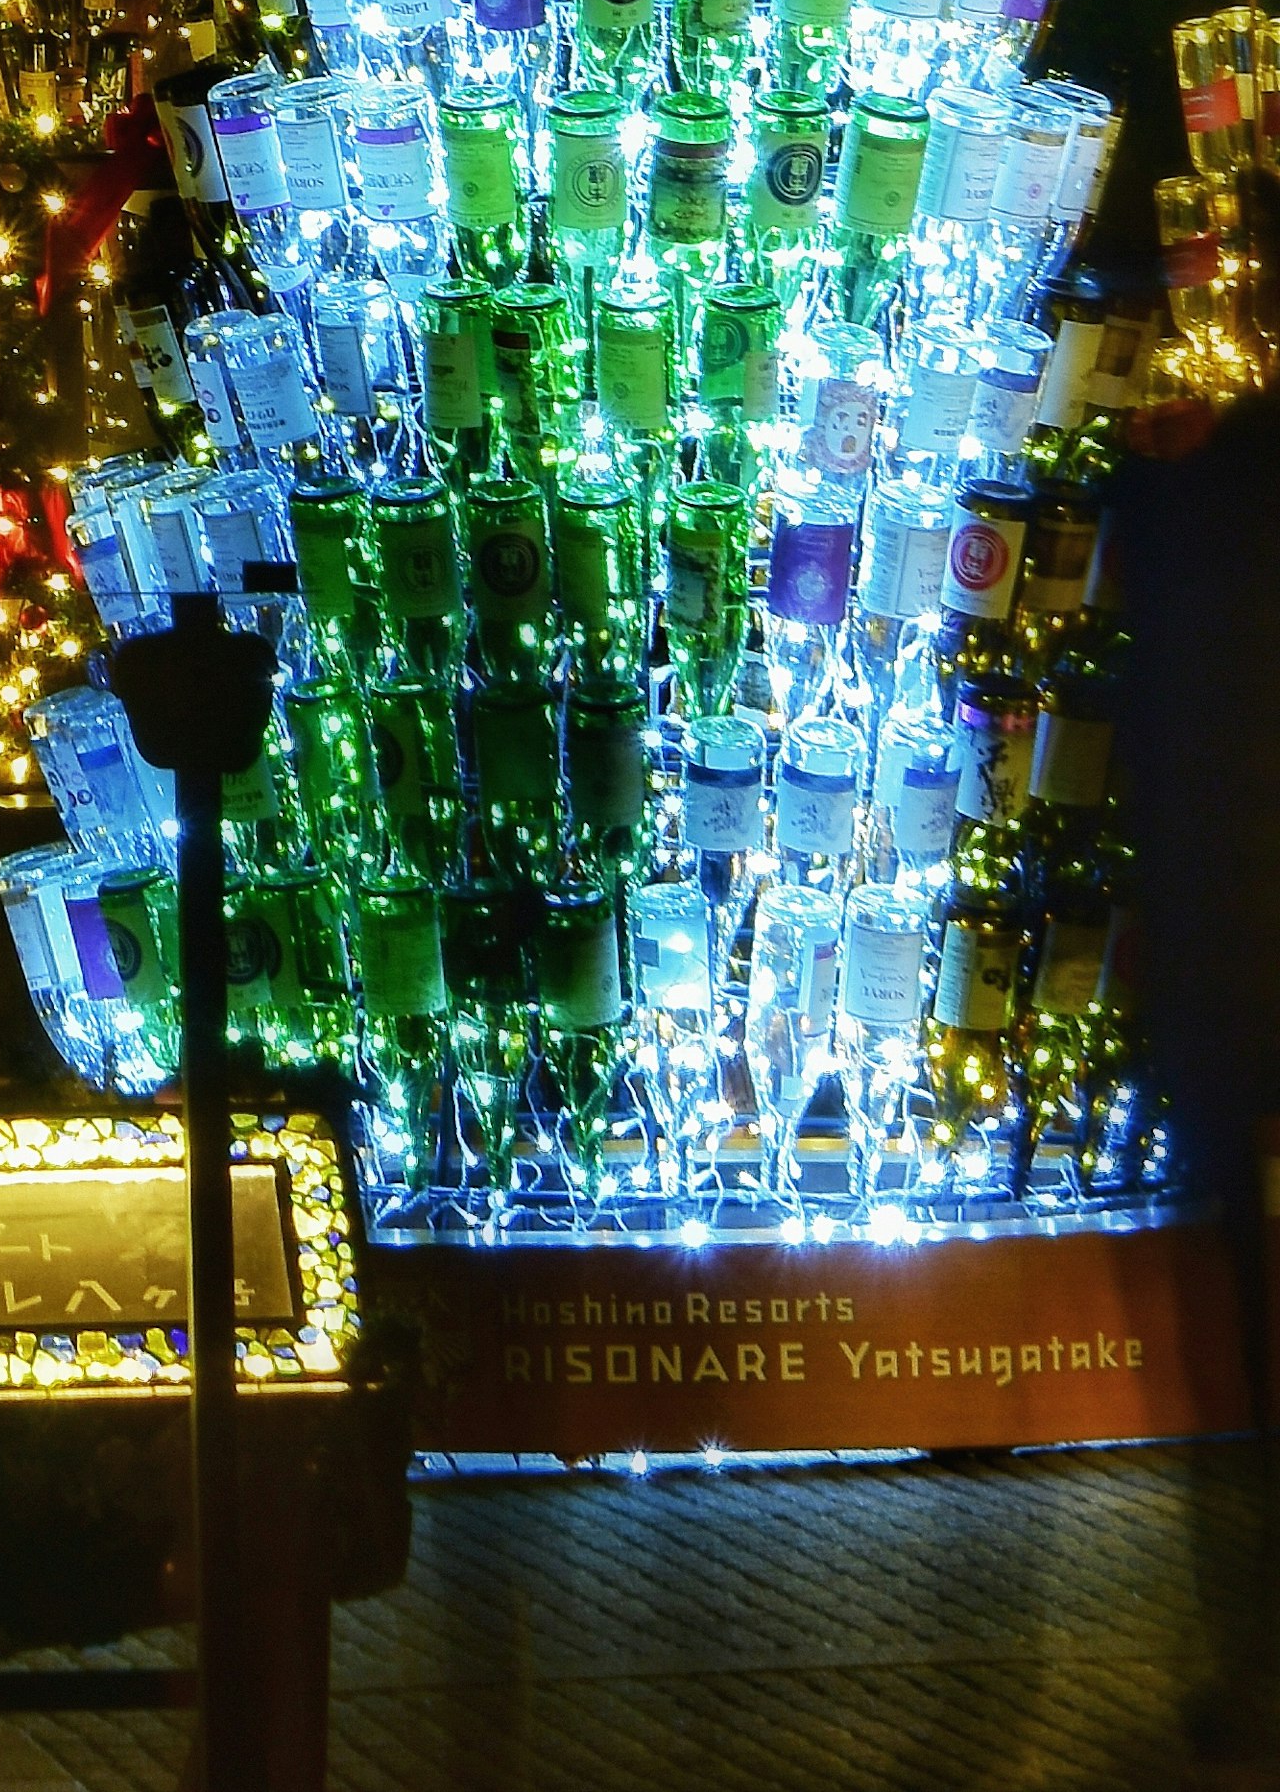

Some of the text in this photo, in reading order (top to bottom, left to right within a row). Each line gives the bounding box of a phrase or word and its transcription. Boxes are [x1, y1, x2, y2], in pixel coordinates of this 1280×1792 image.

[503, 1291, 855, 1325] Hoshino Resorts
[505, 1330, 1145, 1388] RISONARE Yatsugatake
